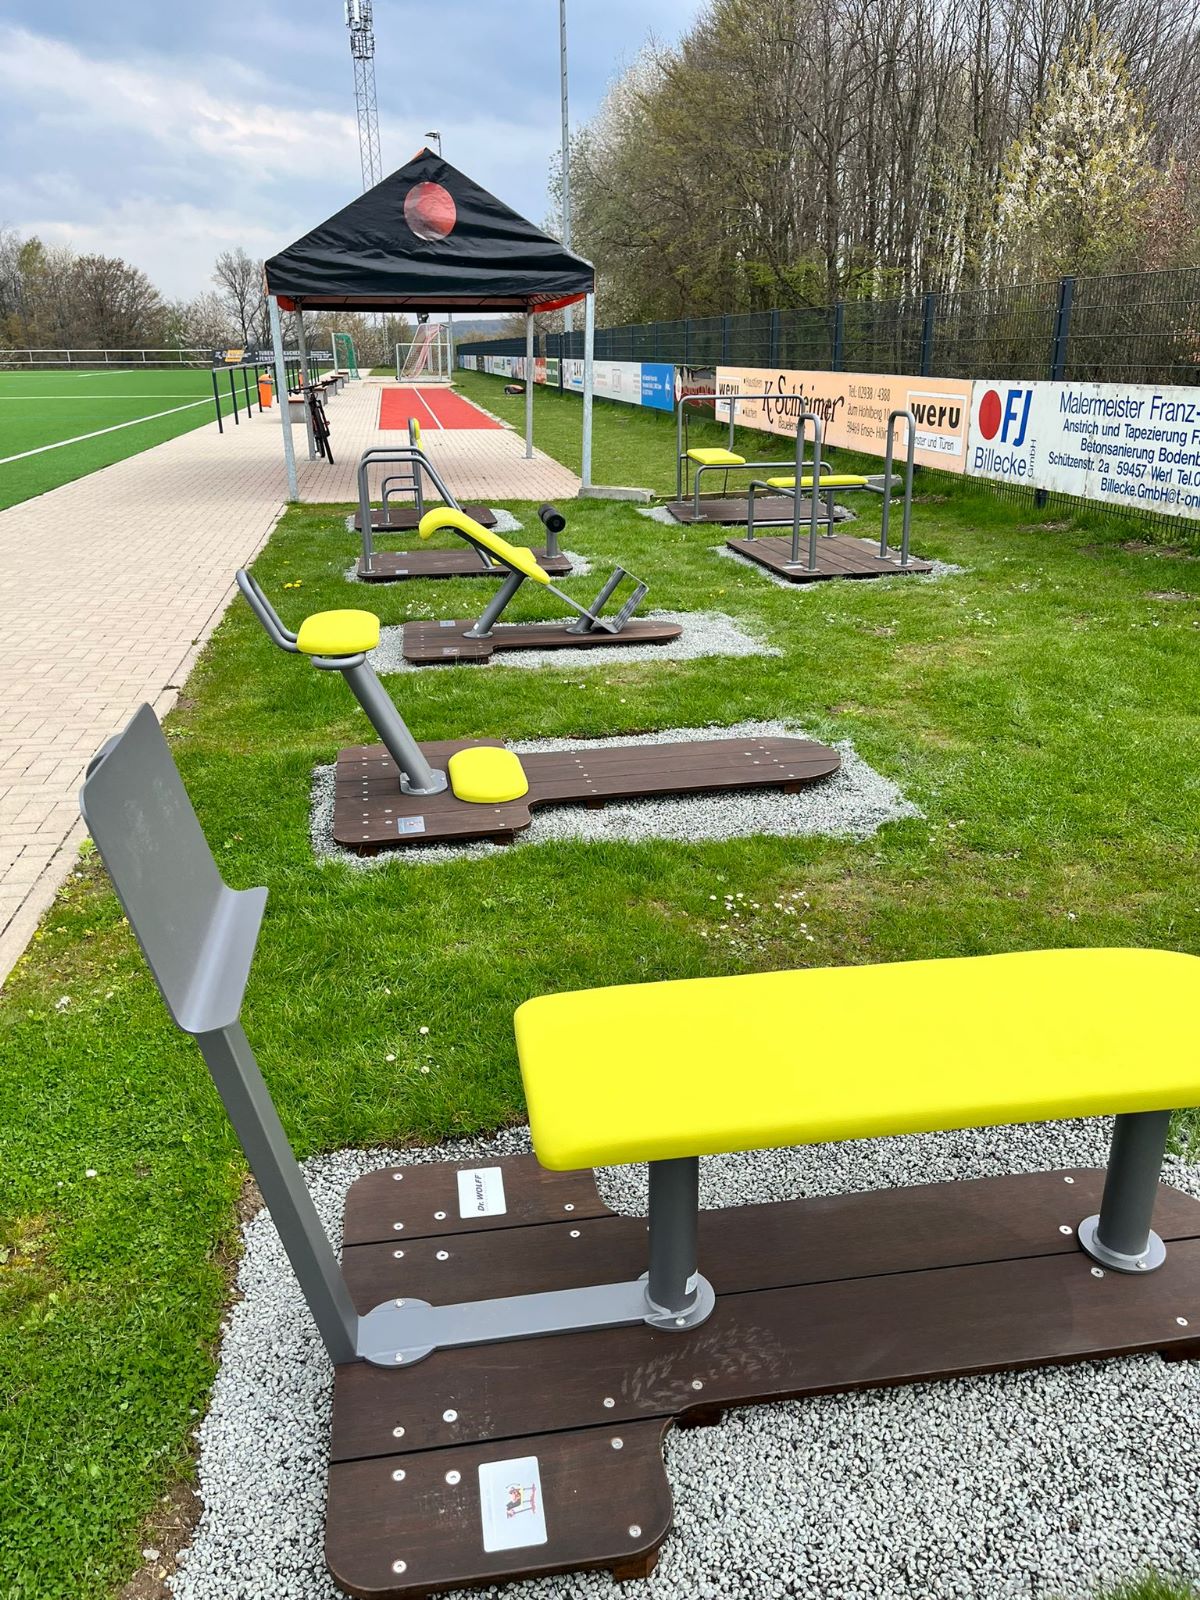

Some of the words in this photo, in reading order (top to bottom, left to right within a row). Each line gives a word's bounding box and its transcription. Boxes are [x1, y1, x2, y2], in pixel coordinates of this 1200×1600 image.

[911, 402, 961, 429] weru
[1000, 389, 1033, 447] FJ
[1060, 391, 1145, 419] Malermeister
[1063, 418, 1099, 436] Anstrich
[1101, 423, 1121, 437] und
[1124, 423, 1188, 447] Tapezierung
[974, 446, 1027, 477] Billecke
[1080, 437, 1155, 464] Betonsanierung
[1048, 451, 1095, 471] Schützenstr.
[1098, 458, 1110, 473] 2a
[1116, 461, 1147, 479] 59457
[1151, 465, 1173, 483] Werl
[474, 1174, 484, 1200] WOLFF
